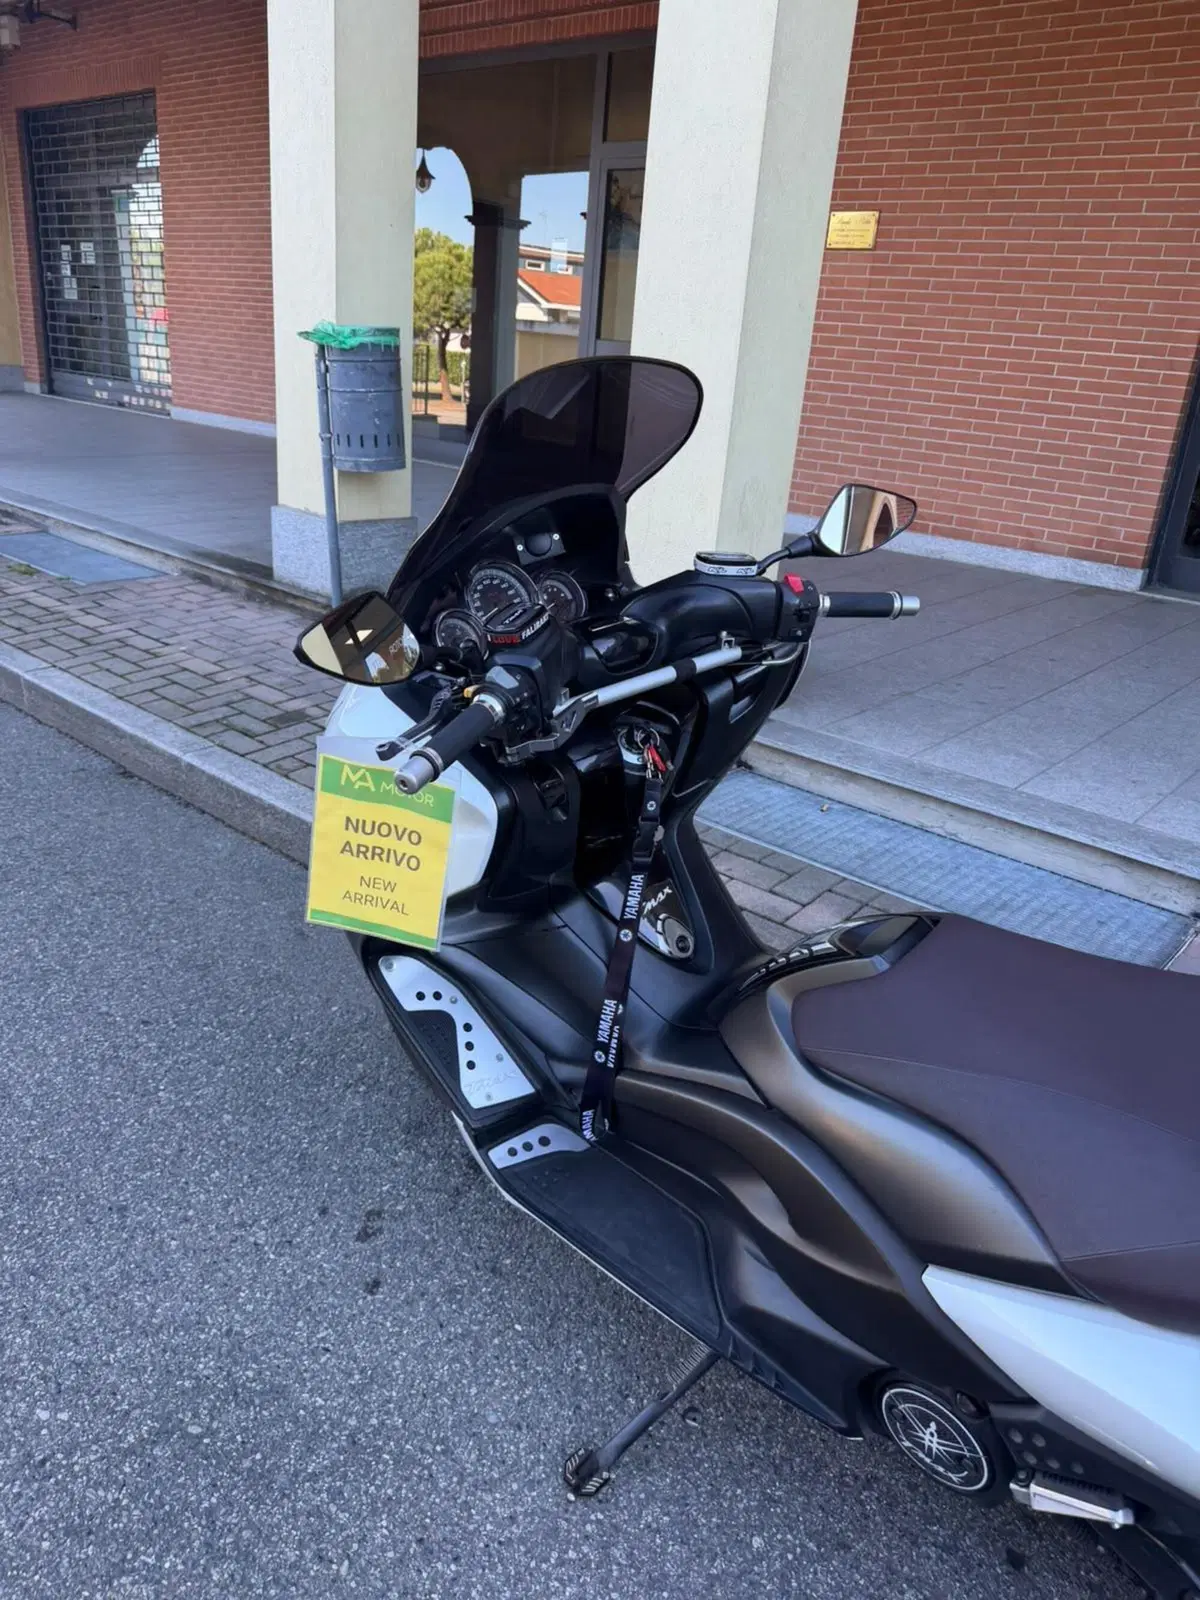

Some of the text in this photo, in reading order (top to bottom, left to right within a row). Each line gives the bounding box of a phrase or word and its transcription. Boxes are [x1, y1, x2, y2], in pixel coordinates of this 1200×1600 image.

[380, 781, 434, 808] MOOR
[344, 816, 422, 846] NUOVO
[340, 841, 421, 872] ARRIVO
[359, 875, 397, 893] NEW
[624, 874, 645, 920] YAMAHA
[342, 890, 409, 916] ARRIVAL
[597, 999, 618, 1044] YAMAHA
